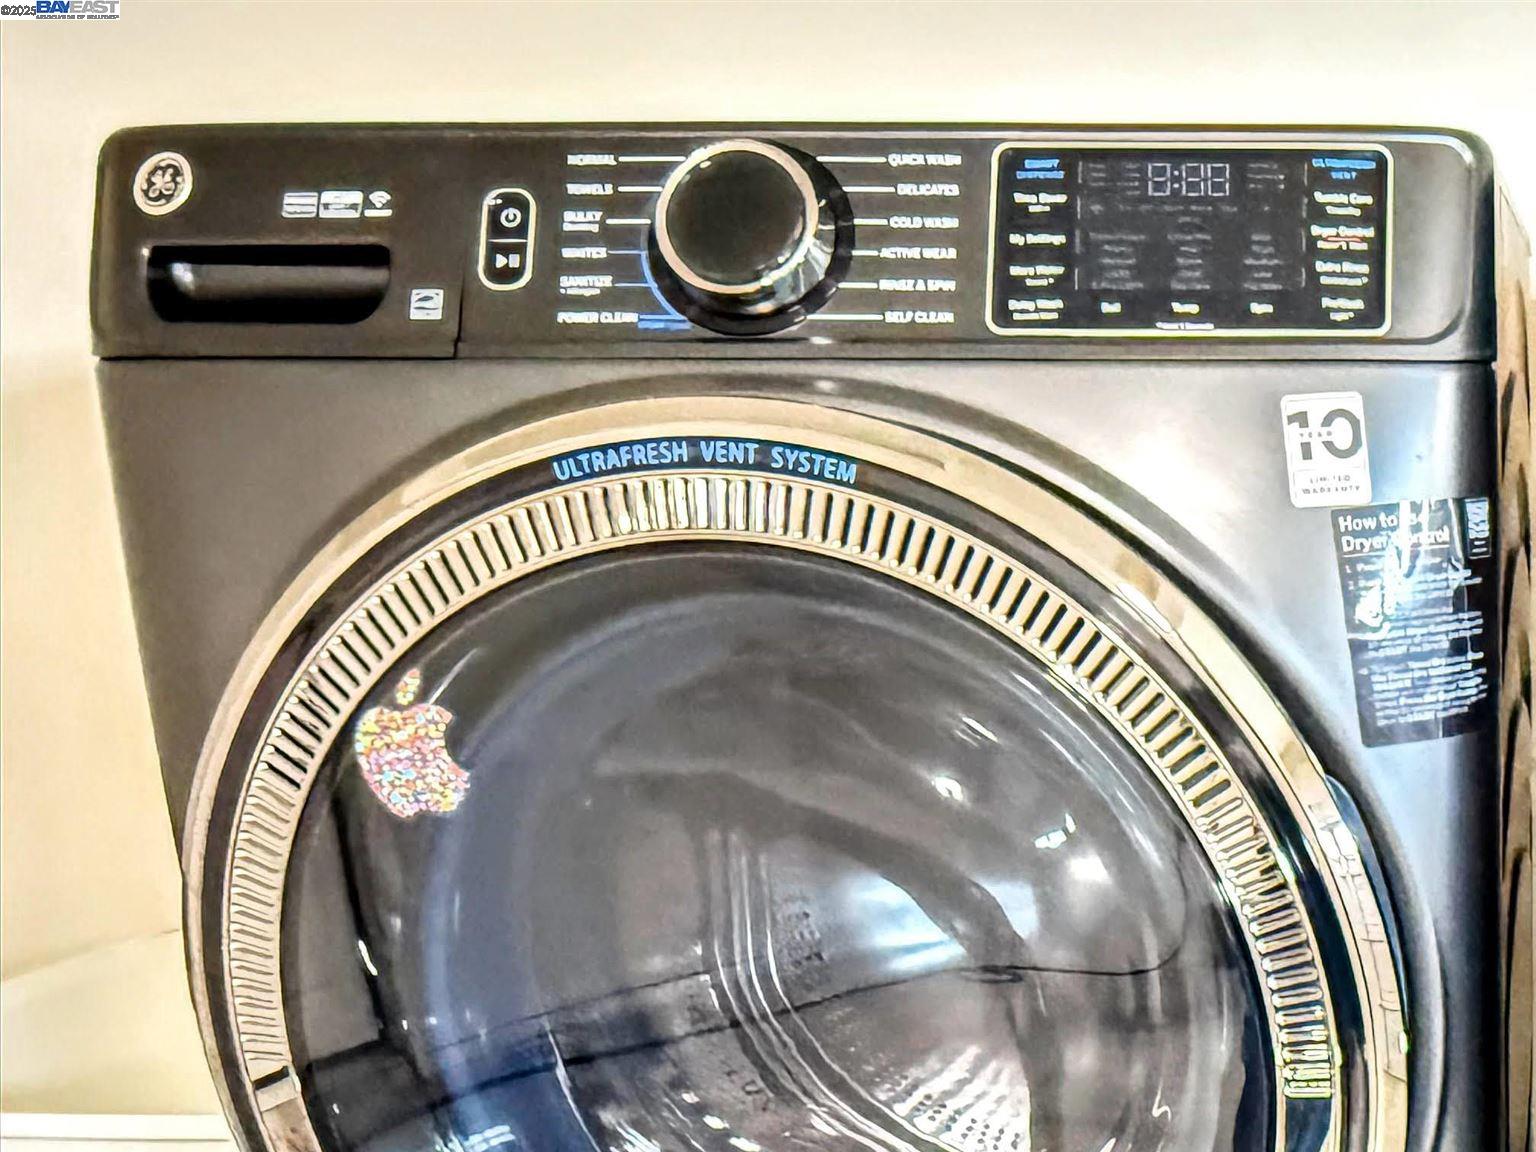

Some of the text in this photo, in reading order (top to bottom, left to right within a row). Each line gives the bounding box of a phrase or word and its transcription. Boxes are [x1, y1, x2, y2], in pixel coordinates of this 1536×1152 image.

[1287, 408, 1363, 460] 10
[552, 440, 857, 484] ULTRAFRESH VENT SYSTEM
[1338, 514, 1376, 533] How
[1379, 511, 1398, 529] to
[1341, 535, 1388, 552] Dryer
